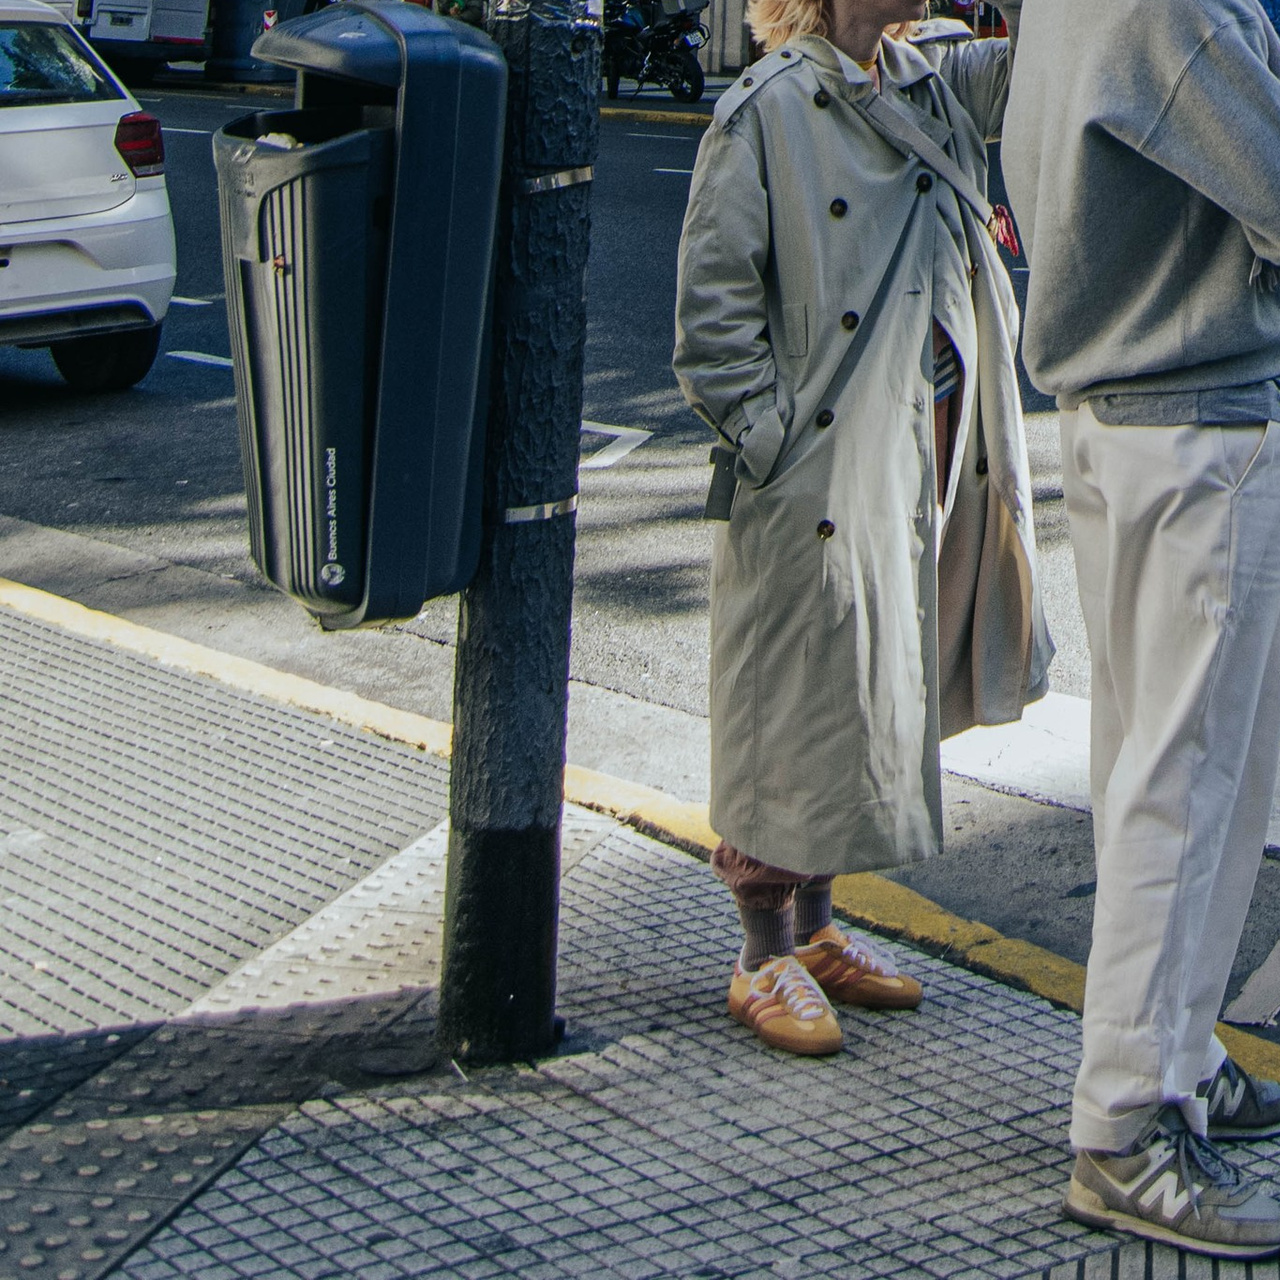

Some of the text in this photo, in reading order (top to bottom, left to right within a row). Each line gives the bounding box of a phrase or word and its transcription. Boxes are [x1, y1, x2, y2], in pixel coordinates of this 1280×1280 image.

[326, 447, 337, 560] Buenos Aires Ciudad
